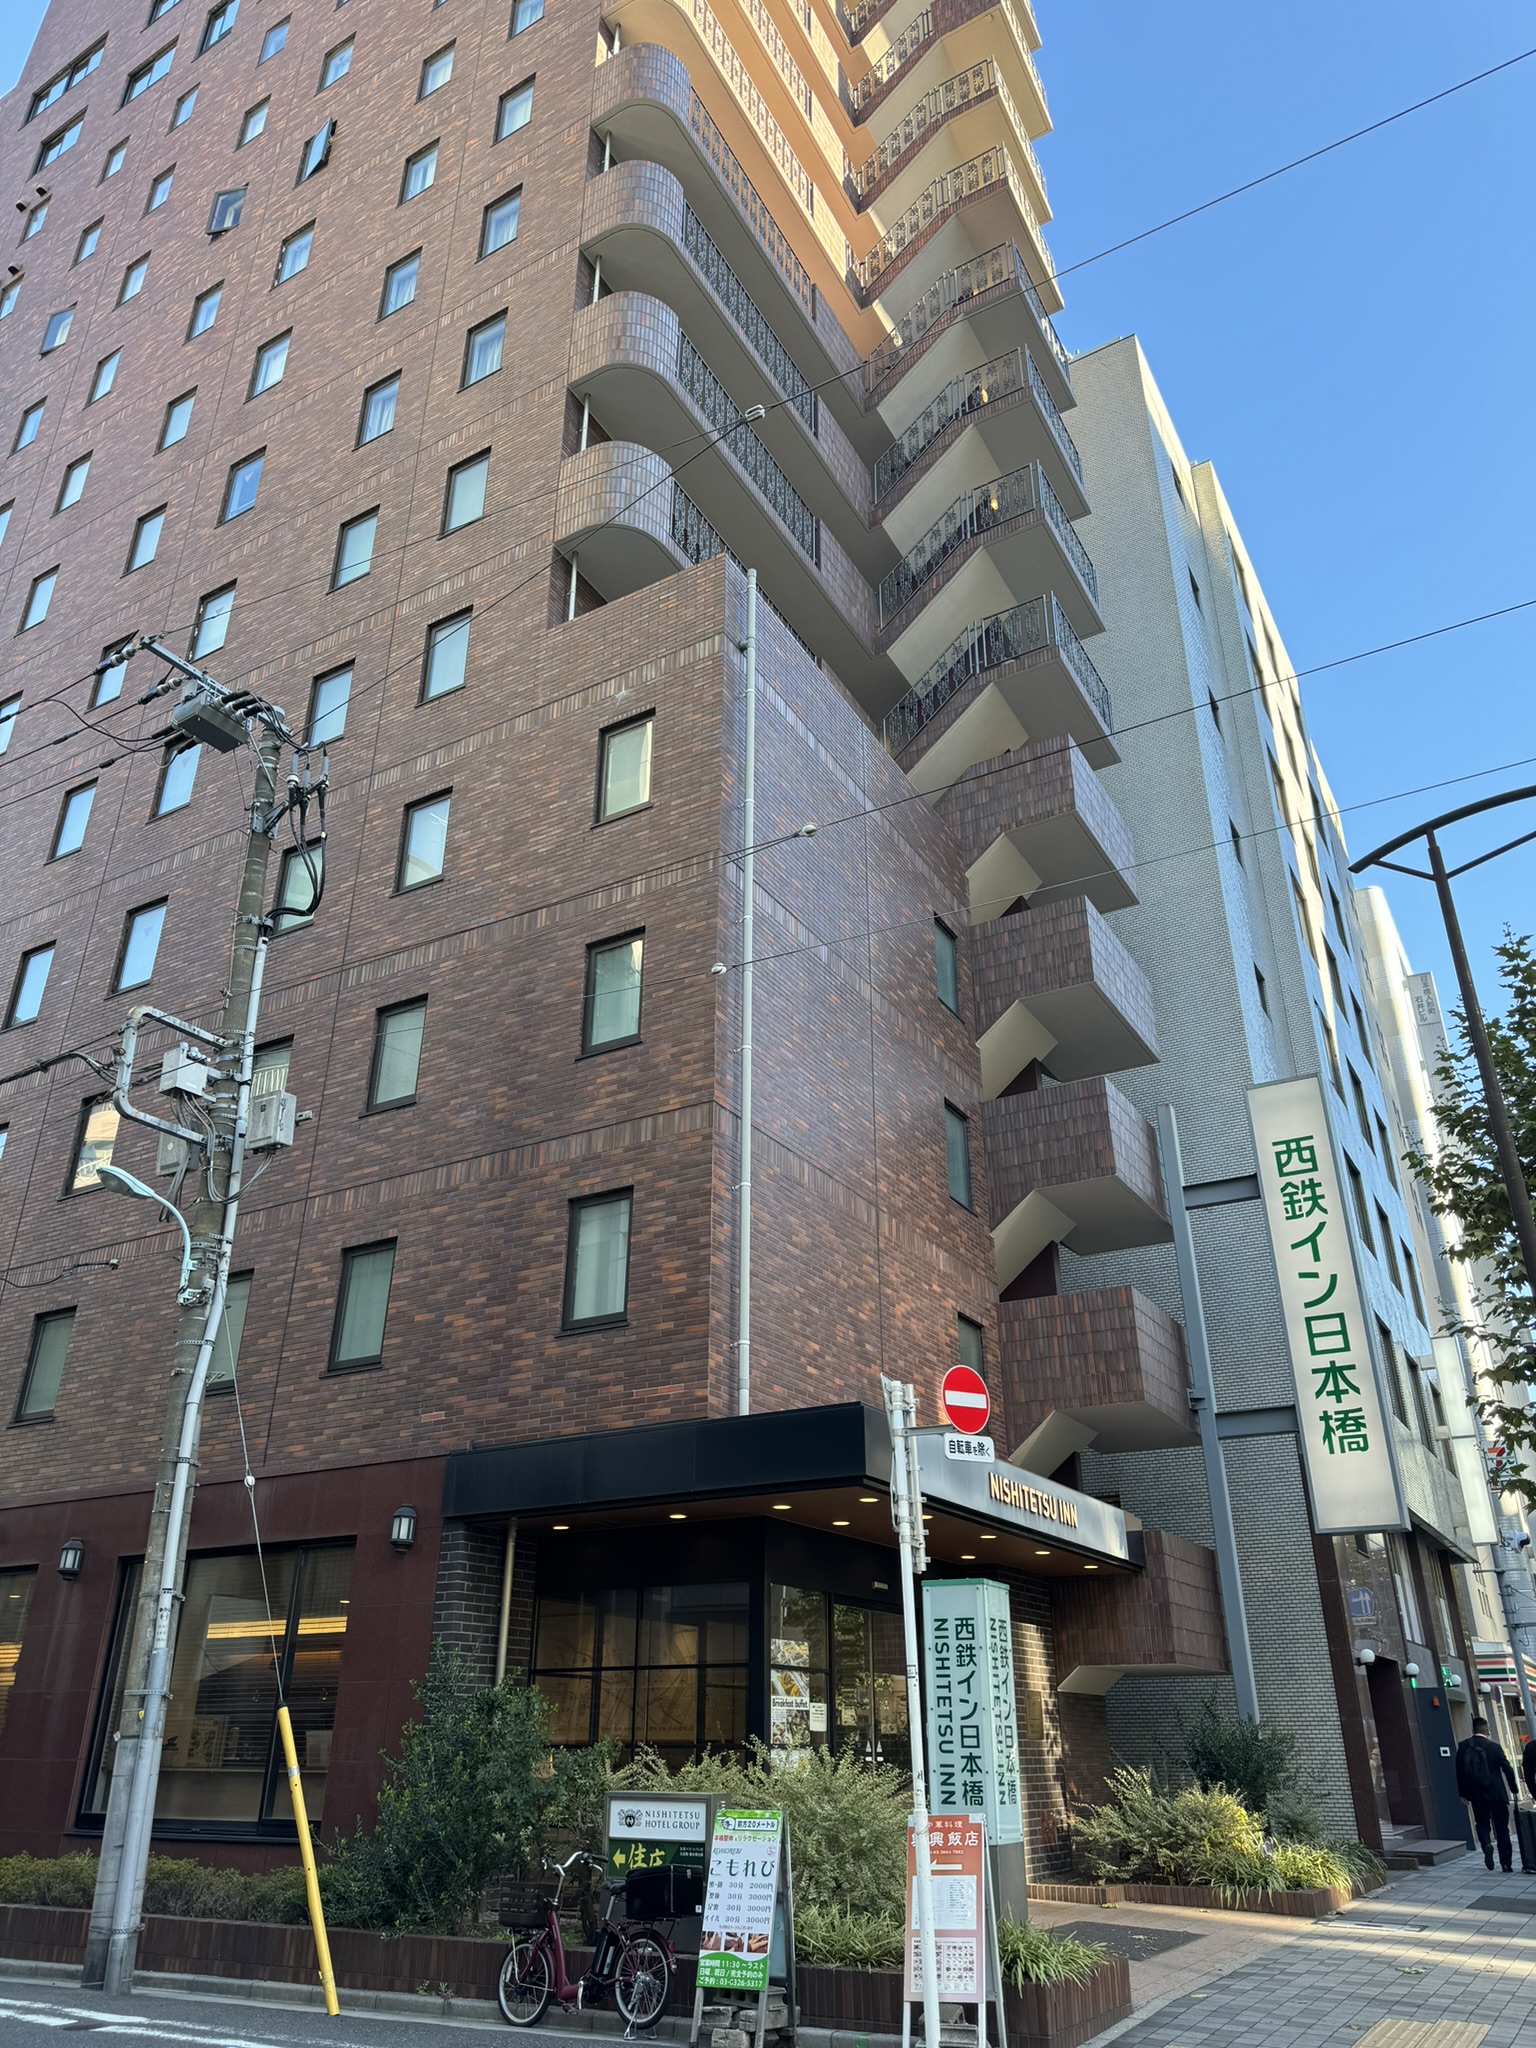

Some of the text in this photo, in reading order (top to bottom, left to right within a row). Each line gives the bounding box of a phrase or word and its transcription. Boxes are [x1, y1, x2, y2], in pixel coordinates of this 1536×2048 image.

[1414, 995, 1428, 1022] 石井ビル
[1271, 1134, 1370, 1455] 西鉄イン日本橋
[949, 1439, 991, 1457] 自転車を除く
[989, 1472, 1079, 1528] NISHITETSU INN
[772, 1698, 794, 1708] Breakfast
[795, 1699, 808, 1708] buffet
[933, 1617, 957, 1805] NISHITETSU INN
[989, 1617, 1007, 1806] NISHITETSU INN
[954, 1617, 984, 1807] 西鉄イン日本橋
[997, 1619, 1018, 1805] 西鉄イン日本橋
[645, 1810, 701, 1820] NISHITETSU
[645, 1820, 701, 1830] HOTEL GROUP
[737, 1820, 776, 1828] 前方20メートル
[911, 1830, 979, 1847] 興飯店
[710, 1858, 775, 1878] こもれび
[749, 1882, 774, 1890] 2000円
[726, 1904, 741, 1912] 30分
[747, 1905, 771, 1913] 3000円
[745, 1916, 770, 1924] 3000円
[700, 1959, 721, 1967] 営業時間
[722, 1960, 740, 1968] 11:30
[730, 1970, 763, 1979] 完全予約のみ
